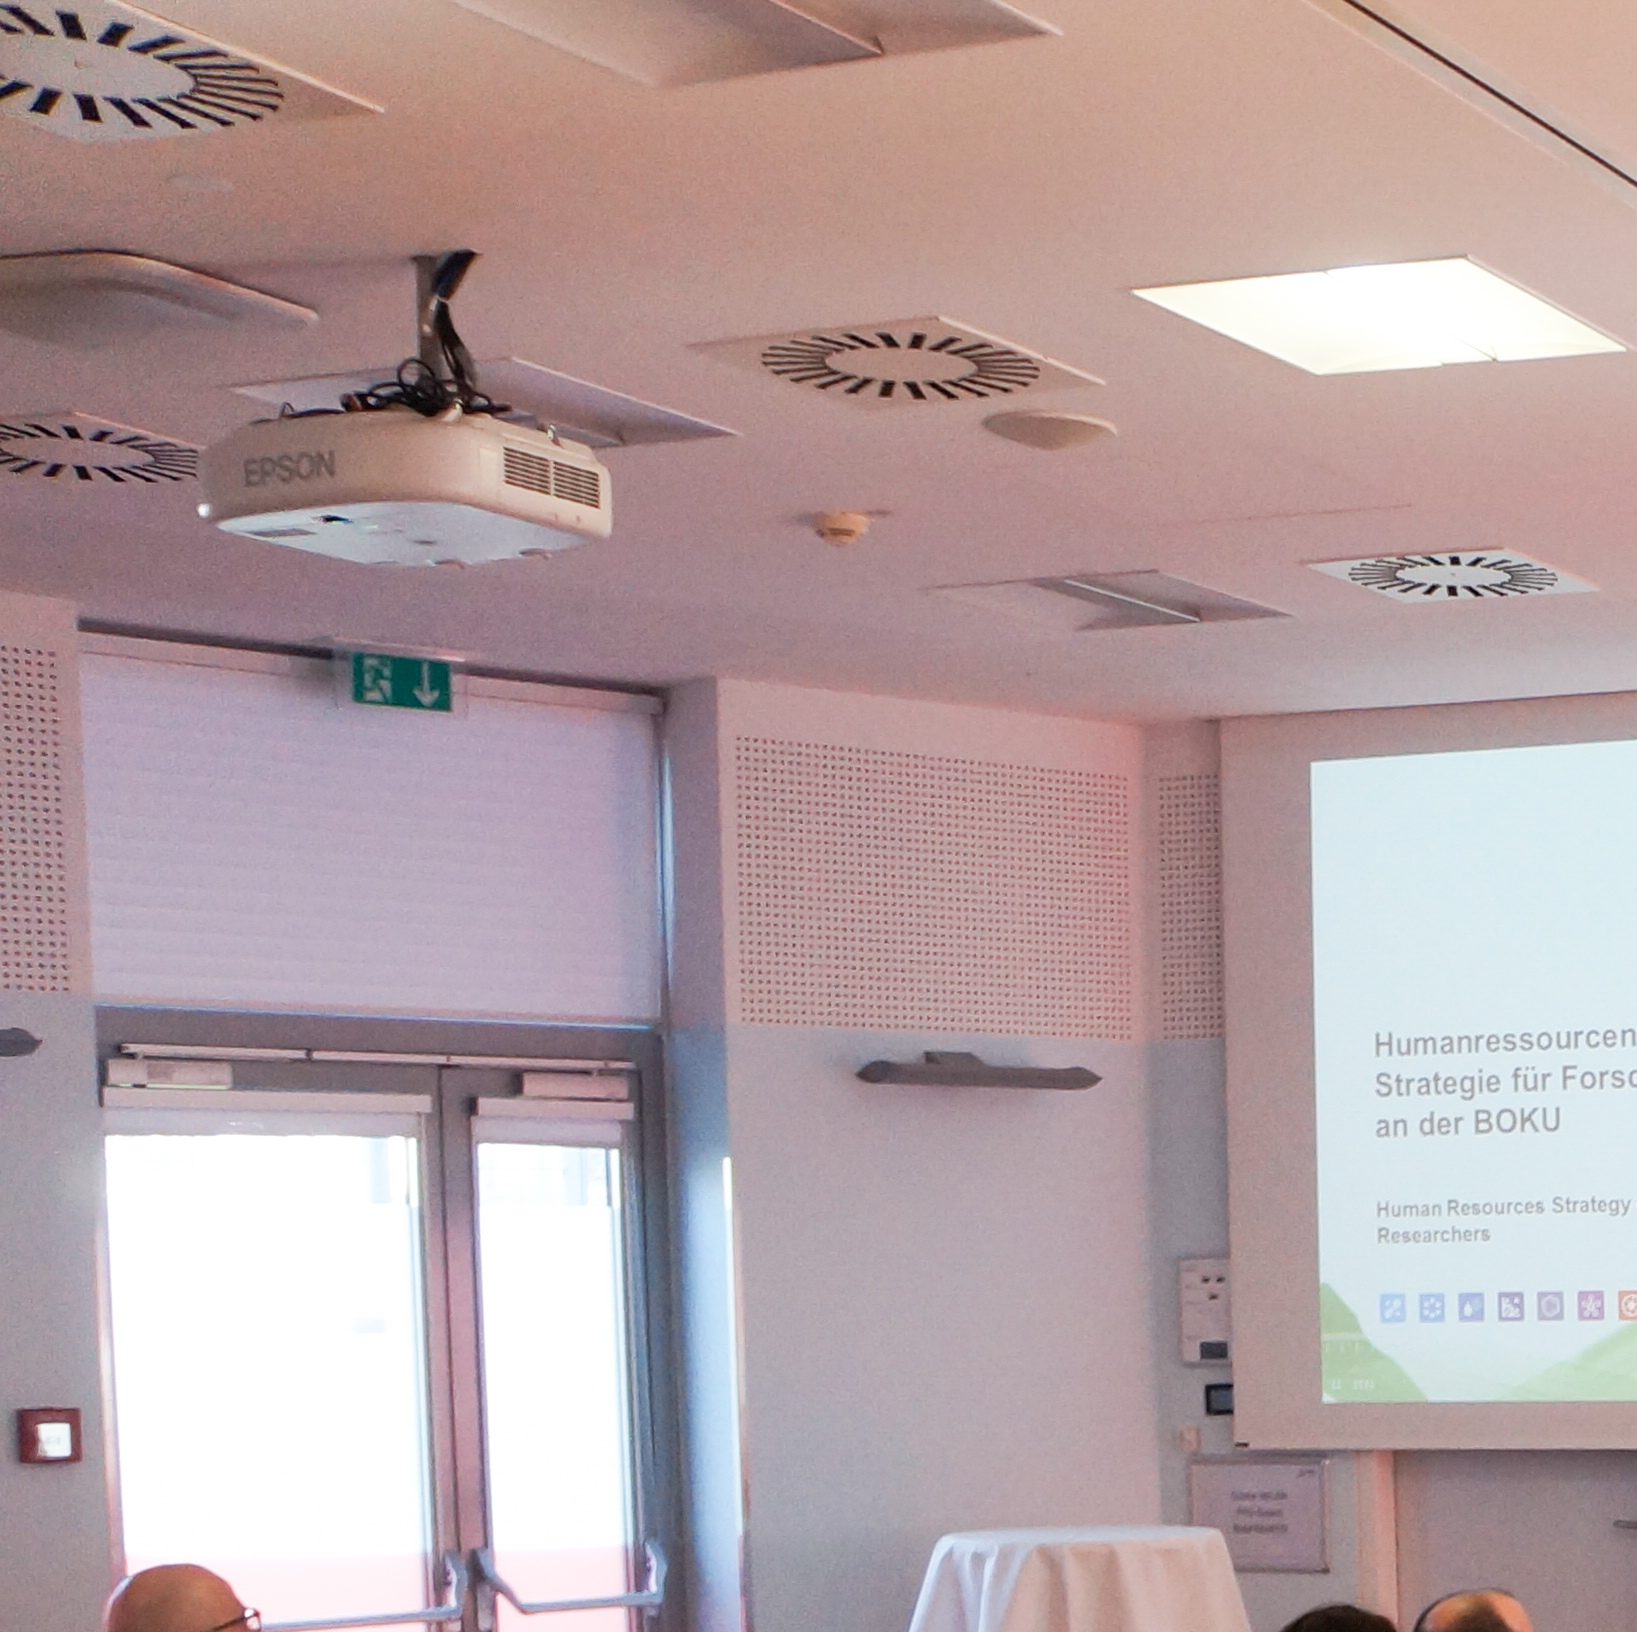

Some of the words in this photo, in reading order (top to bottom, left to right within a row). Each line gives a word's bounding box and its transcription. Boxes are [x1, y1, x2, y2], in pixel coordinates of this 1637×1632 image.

[243, 450, 336, 487] EPSON
[1375, 1069, 1501, 1100] Strategie
[1512, 1065, 1552, 1093] für
[1375, 1117, 1408, 1138] an
[1418, 1111, 1464, 1136] der
[1474, 1106, 1561, 1135] BOKU
[1376, 1200, 1442, 1218] Human
[1447, 1198, 1545, 1216] Resources
[1551, 1196, 1631, 1217] Strategy
[1377, 1226, 1490, 1244] Researchers
